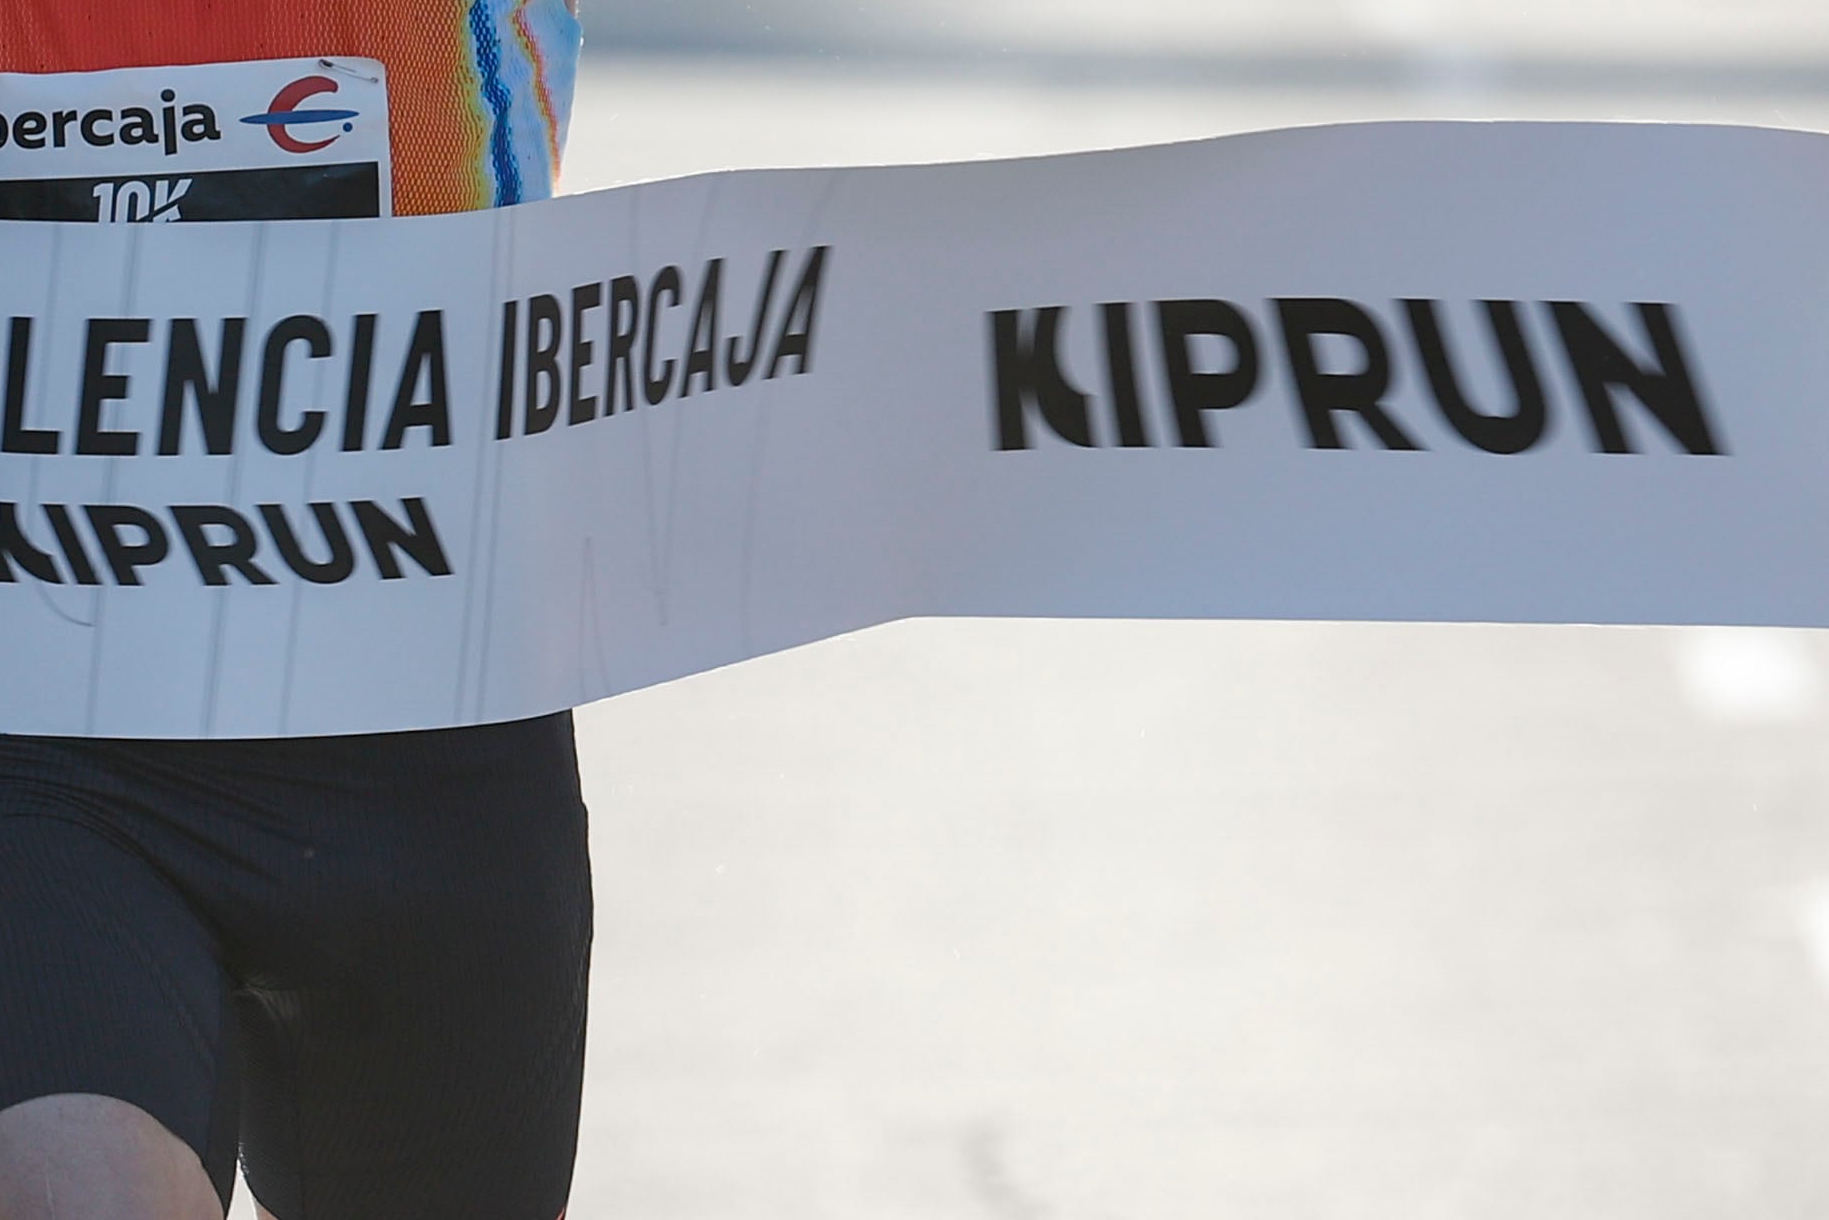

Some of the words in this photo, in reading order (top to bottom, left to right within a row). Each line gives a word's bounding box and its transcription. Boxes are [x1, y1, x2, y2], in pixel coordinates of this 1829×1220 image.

[92, 179, 193, 221] 10K
[495, 245, 832, 441] IBERCAJA
[986, 297, 1730, 457] KIPRUN
